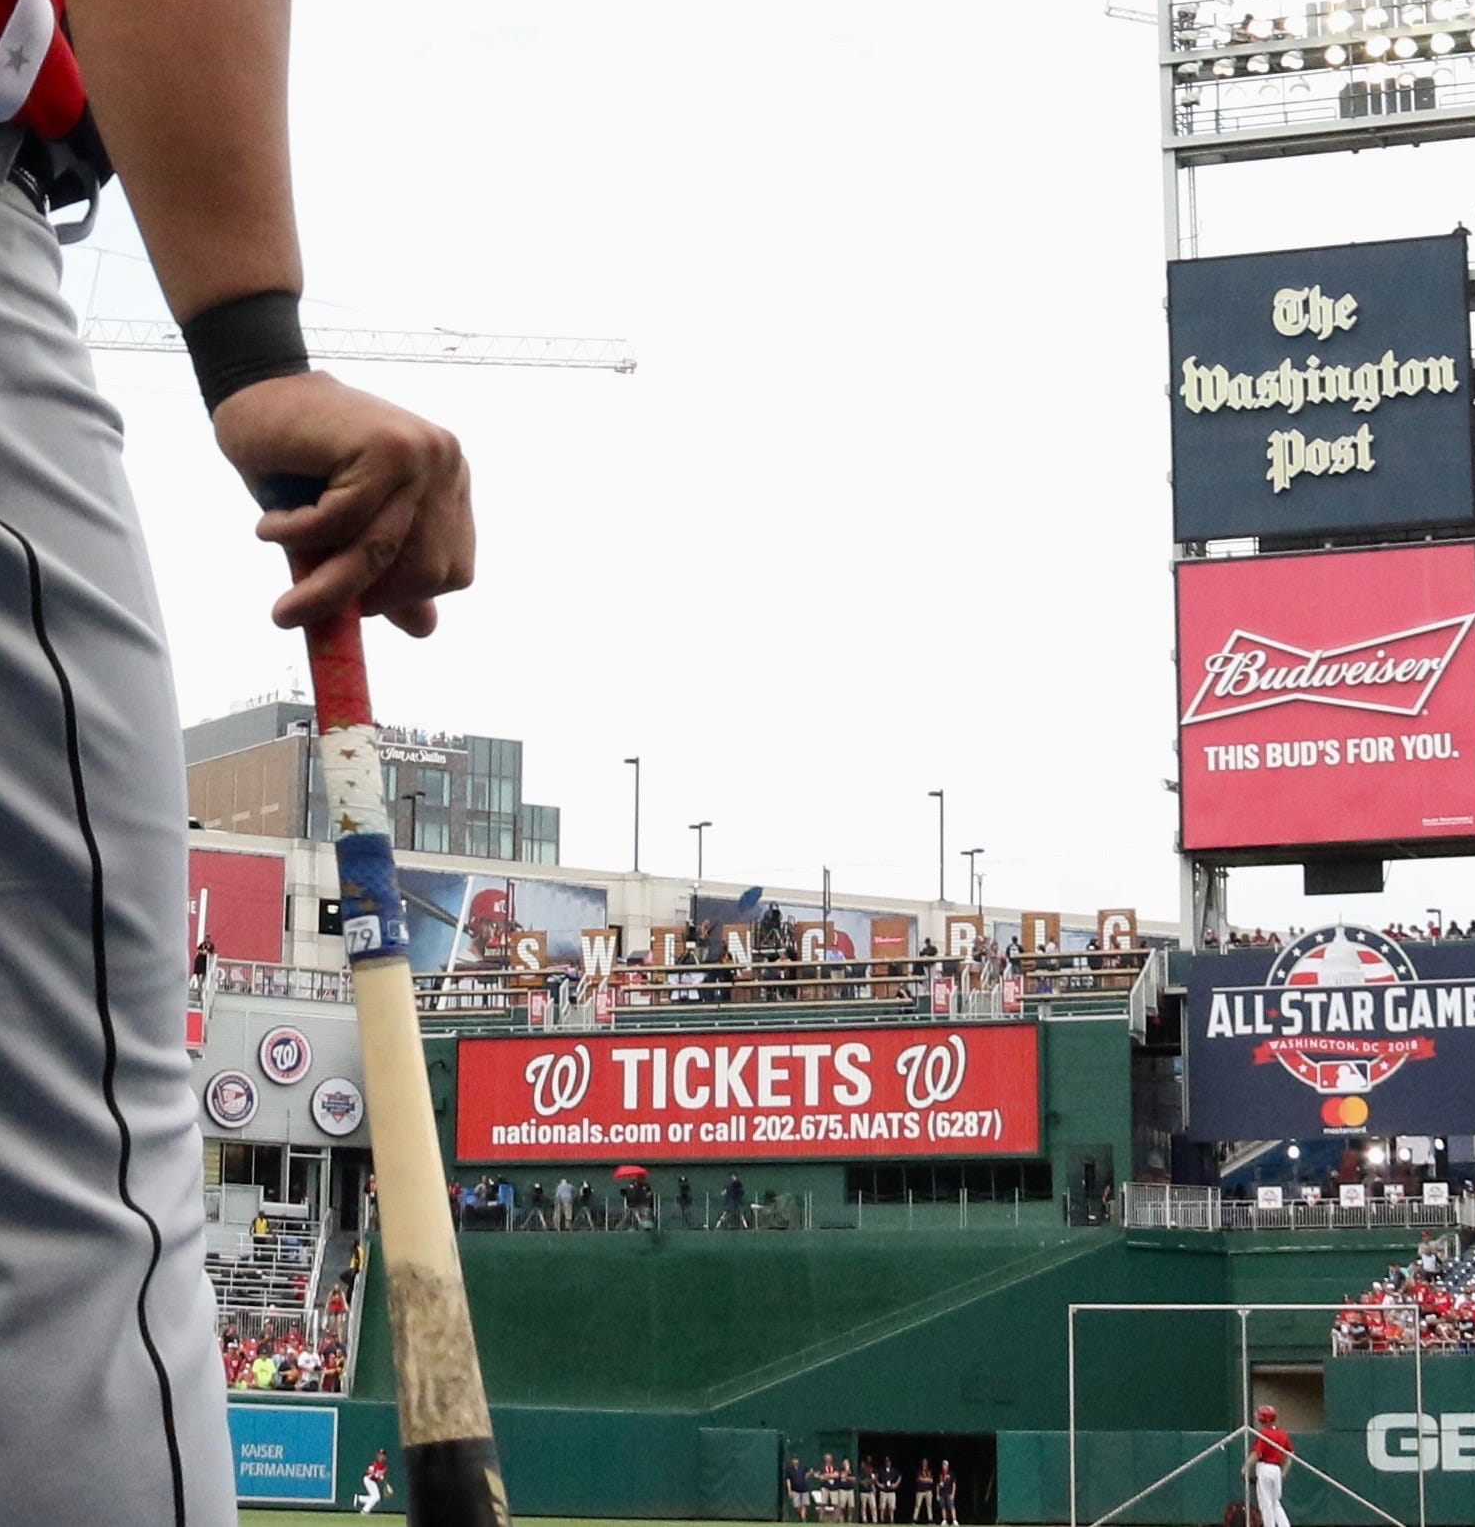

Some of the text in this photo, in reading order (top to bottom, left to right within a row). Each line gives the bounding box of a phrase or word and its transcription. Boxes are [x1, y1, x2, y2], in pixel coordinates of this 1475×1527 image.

[1272, 285, 1358, 341] The
[1180, 349, 1460, 414] Washington
[1266, 422, 1377, 494] Post
[1202, 644, 1447, 701] Budweiser
[1205, 731, 1460, 773] THIS BUD'S FOR YOU.
[348, 929, 373, 955] 79
[1206, 992, 1274, 1039] ALL
[1280, 989, 1375, 1036] STAR
[1268, 1038, 1419, 1053] WASHINGTON, DC 2018
[611, 1041, 873, 1111] TICKETS
[492, 1108, 1004, 1146] nationals.com or call 202.675.NATS (6287)
[1323, 1125, 1368, 1135] mastercard
[240, 1461, 327, 1479] PERMANENTE
[241, 1443, 284, 1459] KAISER
